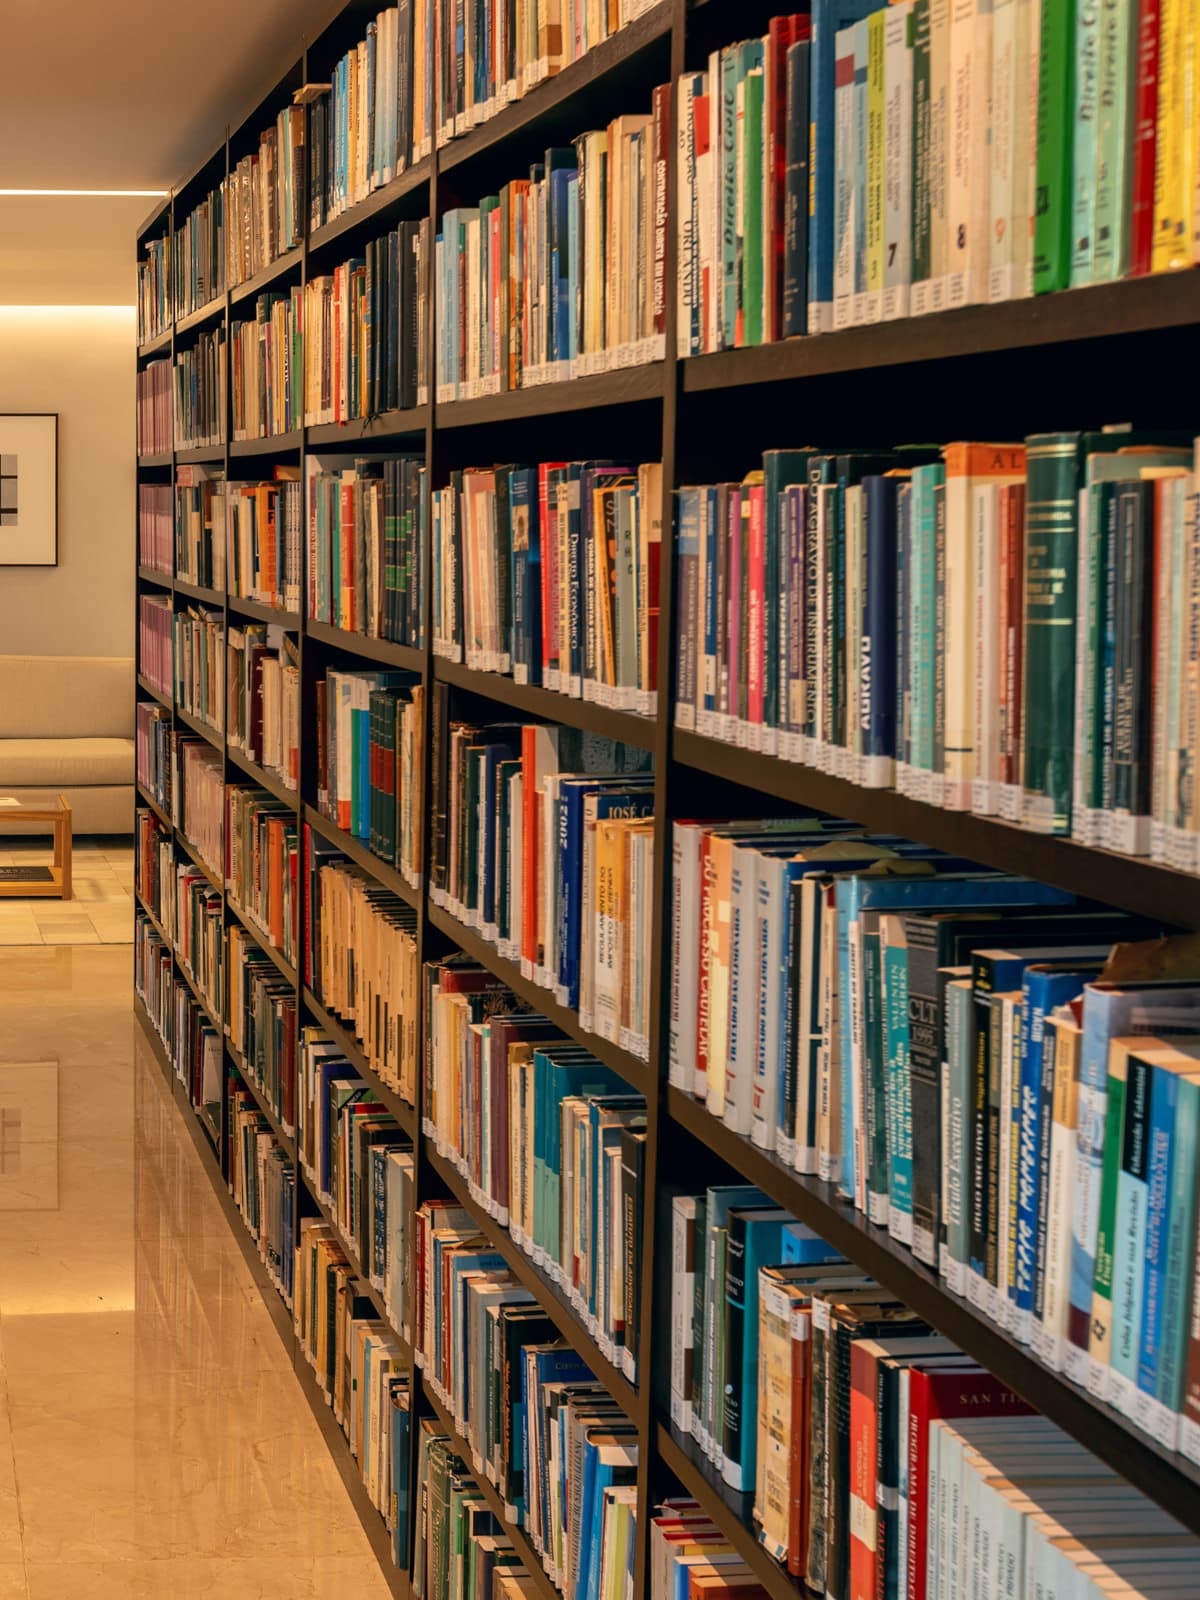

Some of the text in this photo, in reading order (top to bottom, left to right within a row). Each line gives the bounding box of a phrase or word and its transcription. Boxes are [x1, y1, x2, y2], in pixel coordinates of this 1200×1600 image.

[656, 160, 667, 225] CONTRATAÇÃO
[655, 228, 664, 260] DIRETA
[654, 279, 665, 315] LICITAÇÃO
[687, 560, 696, 622] EXECUÇÃO
[806, 469, 821, 723] DO AGRAVO DE INSTRUMENTO
[686, 640, 694, 699] PROCESSO
[861, 636, 871, 730] AGRAVO
[560, 805, 569, 848] 2002
[701, 886, 711, 971] PROCESSO
[732, 908, 740, 976] LIMINARES
[761, 919, 769, 988] LIMINARES
[699, 976, 710, 1056] CAUTELAR
[908, 998, 937, 1021] CLT
[912, 1026, 933, 1046] 1995
[1032, 1007, 1044, 1042] NAGIB
[949, 1097, 962, 1225] Título Executivo
[1130, 1123, 1142, 1174] Eduardo
[1123, 1277, 1135, 1322] Julgada
[960, 1393, 991, 1405] SAN
[908, 1414, 918, 1579] PROGRAMA DE DIREITO
